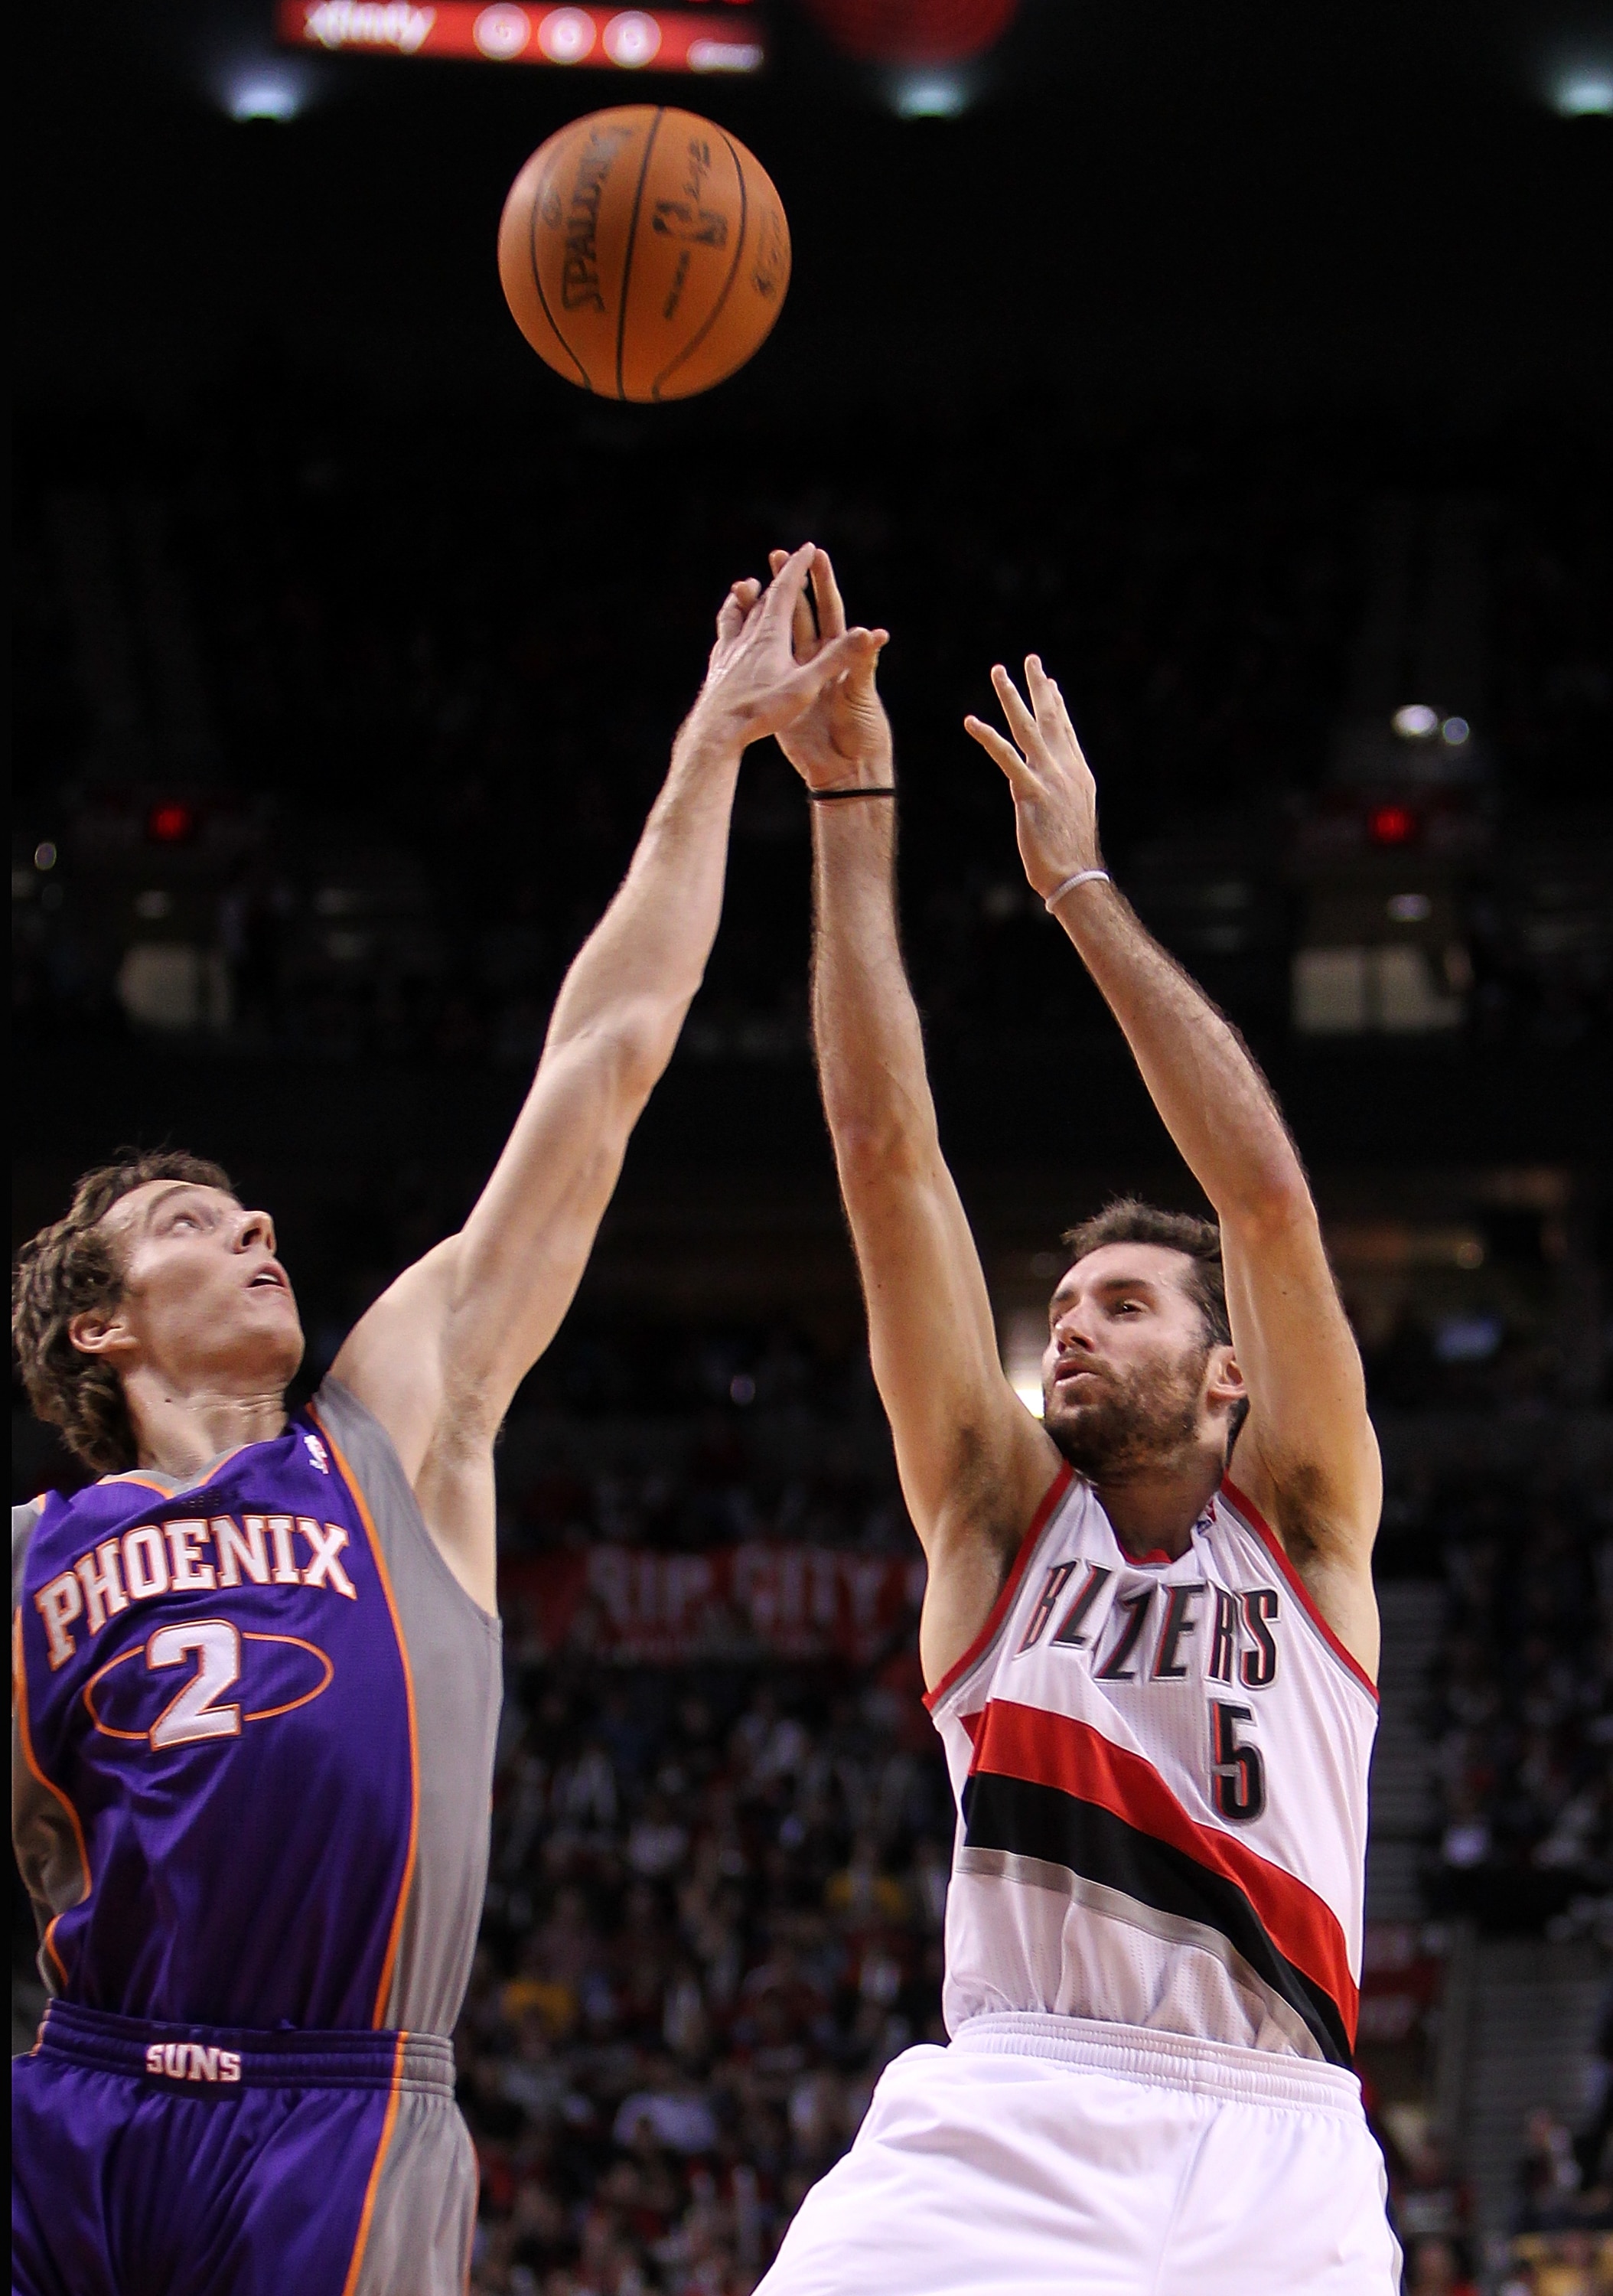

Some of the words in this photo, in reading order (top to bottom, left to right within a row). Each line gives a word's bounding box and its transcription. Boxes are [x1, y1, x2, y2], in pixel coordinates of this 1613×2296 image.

[562, 125, 632, 312] SPALD
[34, 1514, 358, 1671] PHOENIX
[1013, 1557, 1280, 1691] BLZERS
[146, 1619, 242, 1752] 2
[1206, 1697, 1267, 1828] 5
[146, 2043, 241, 2082] SUNS
